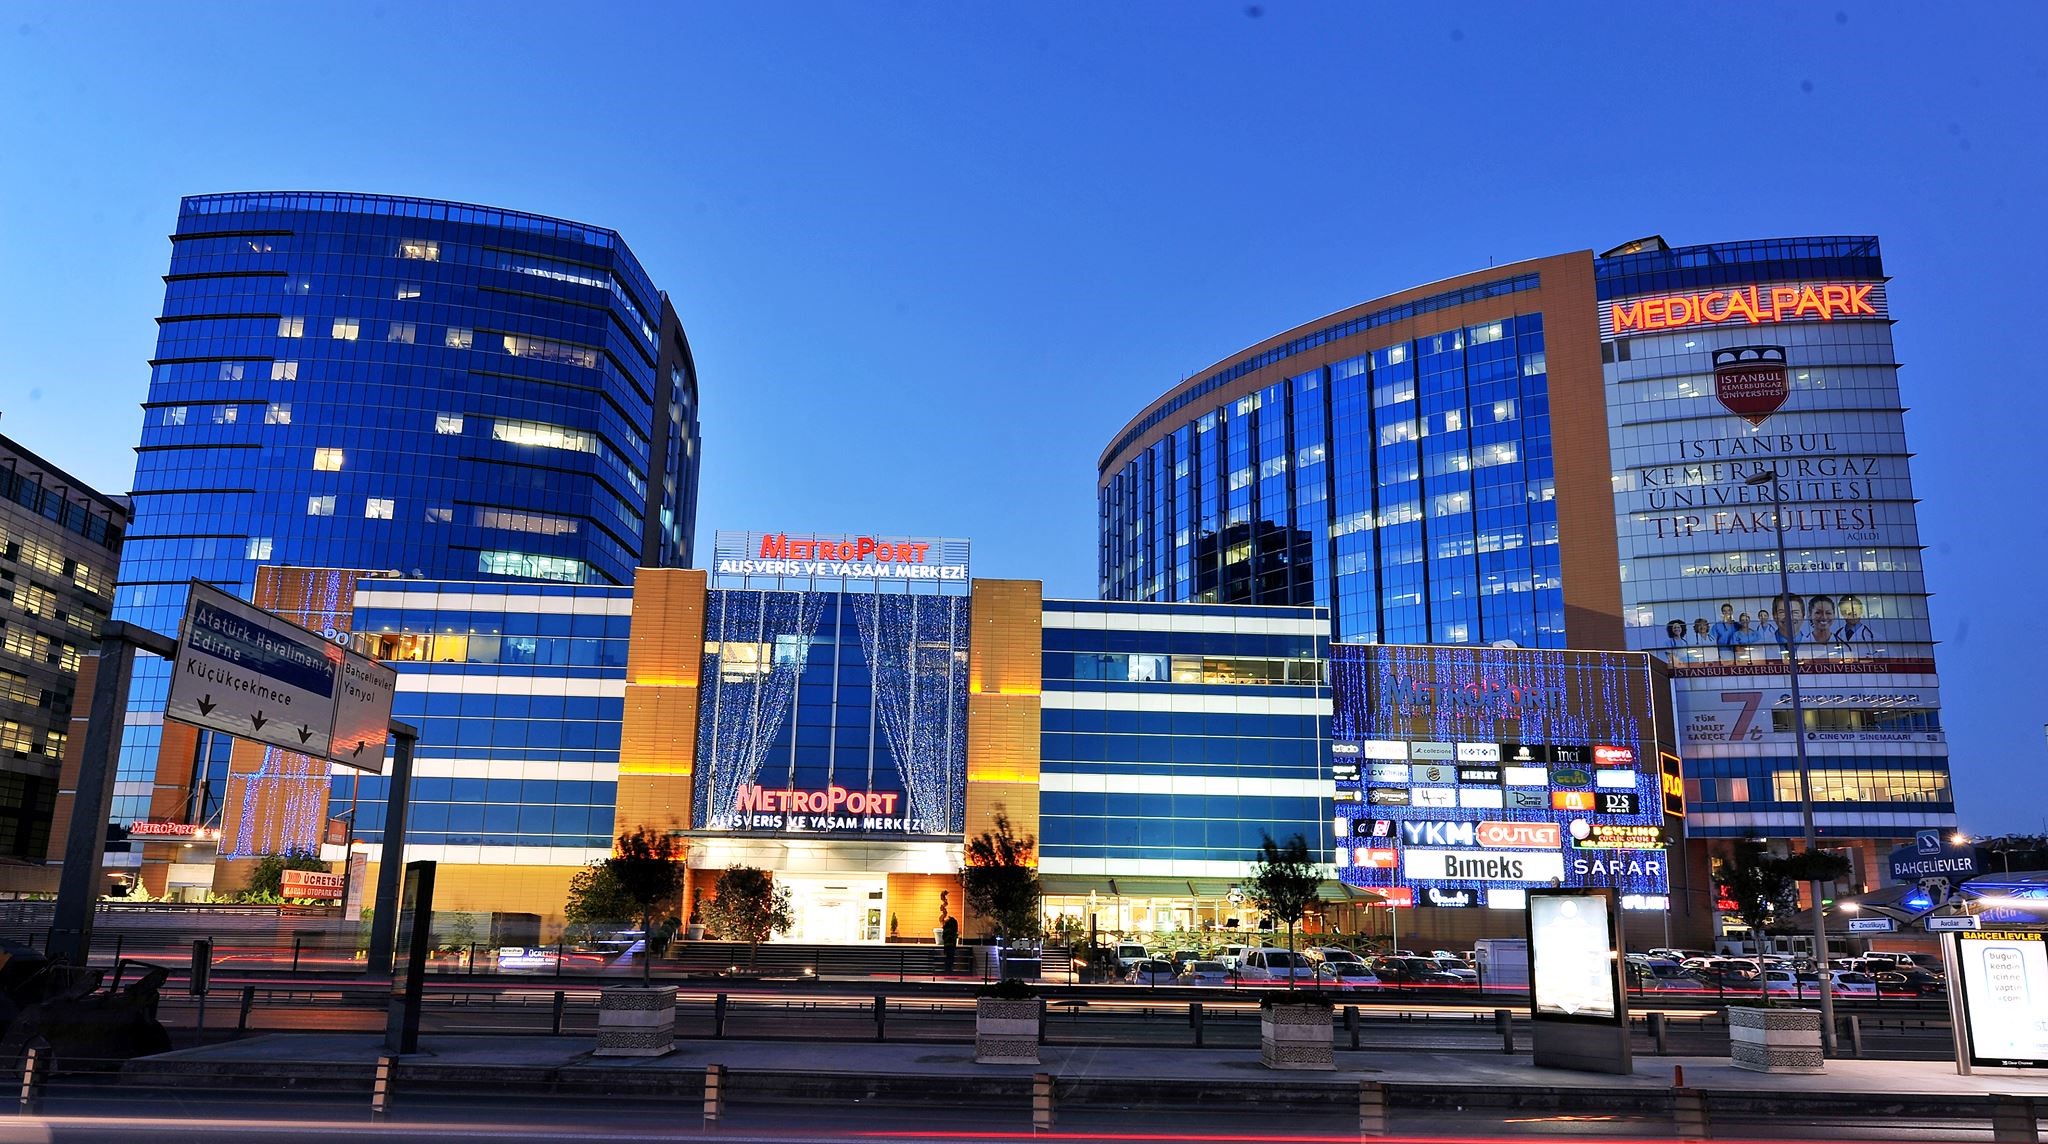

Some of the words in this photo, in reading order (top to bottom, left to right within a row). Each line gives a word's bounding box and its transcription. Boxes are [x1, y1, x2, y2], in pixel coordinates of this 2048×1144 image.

[1722, 381, 1782, 391] KEMERBURGAZ
[1642, 457, 1879, 487] KEMERBURGAZ
[1649, 478, 1875, 510] ÜNİVERSİTESİ
[1650, 515, 1700, 539] TIP
[719, 558, 800, 577] ALIŞVERİŞ
[806, 562, 826, 576] VE
[830, 562, 890, 579] YAŞAM
[895, 563, 965, 580] MERKEZİ
[191, 631, 241, 662] Edirne
[196, 608, 250, 643] Atatürk
[256, 633, 323, 672] Havalimanı
[345, 662, 393, 692] Bahçelievler
[1730, 664, 1812, 676] KEMERBURAZ
[187, 658, 292, 706] Küçükçekmece
[344, 682, 375, 704] Yanyol
[1859, 732, 1911, 741] SİNEMALARI
[1663, 772, 1682, 797] FLO
[788, 816, 806, 830] VE
[811, 816, 858, 831] YAŞAM
[1404, 821, 1473, 845] YKM
[1488, 827, 1557, 844] OUTLET
[1574, 859, 1660, 876] SARAR
[1894, 857, 1973, 878] BAHÇELİEVLER
[303, 872, 345, 887] ÜCRETSİZ
[307, 887, 332, 897] OTOPARK
[1963, 931, 2042, 941] BAHÇELİEVLER
